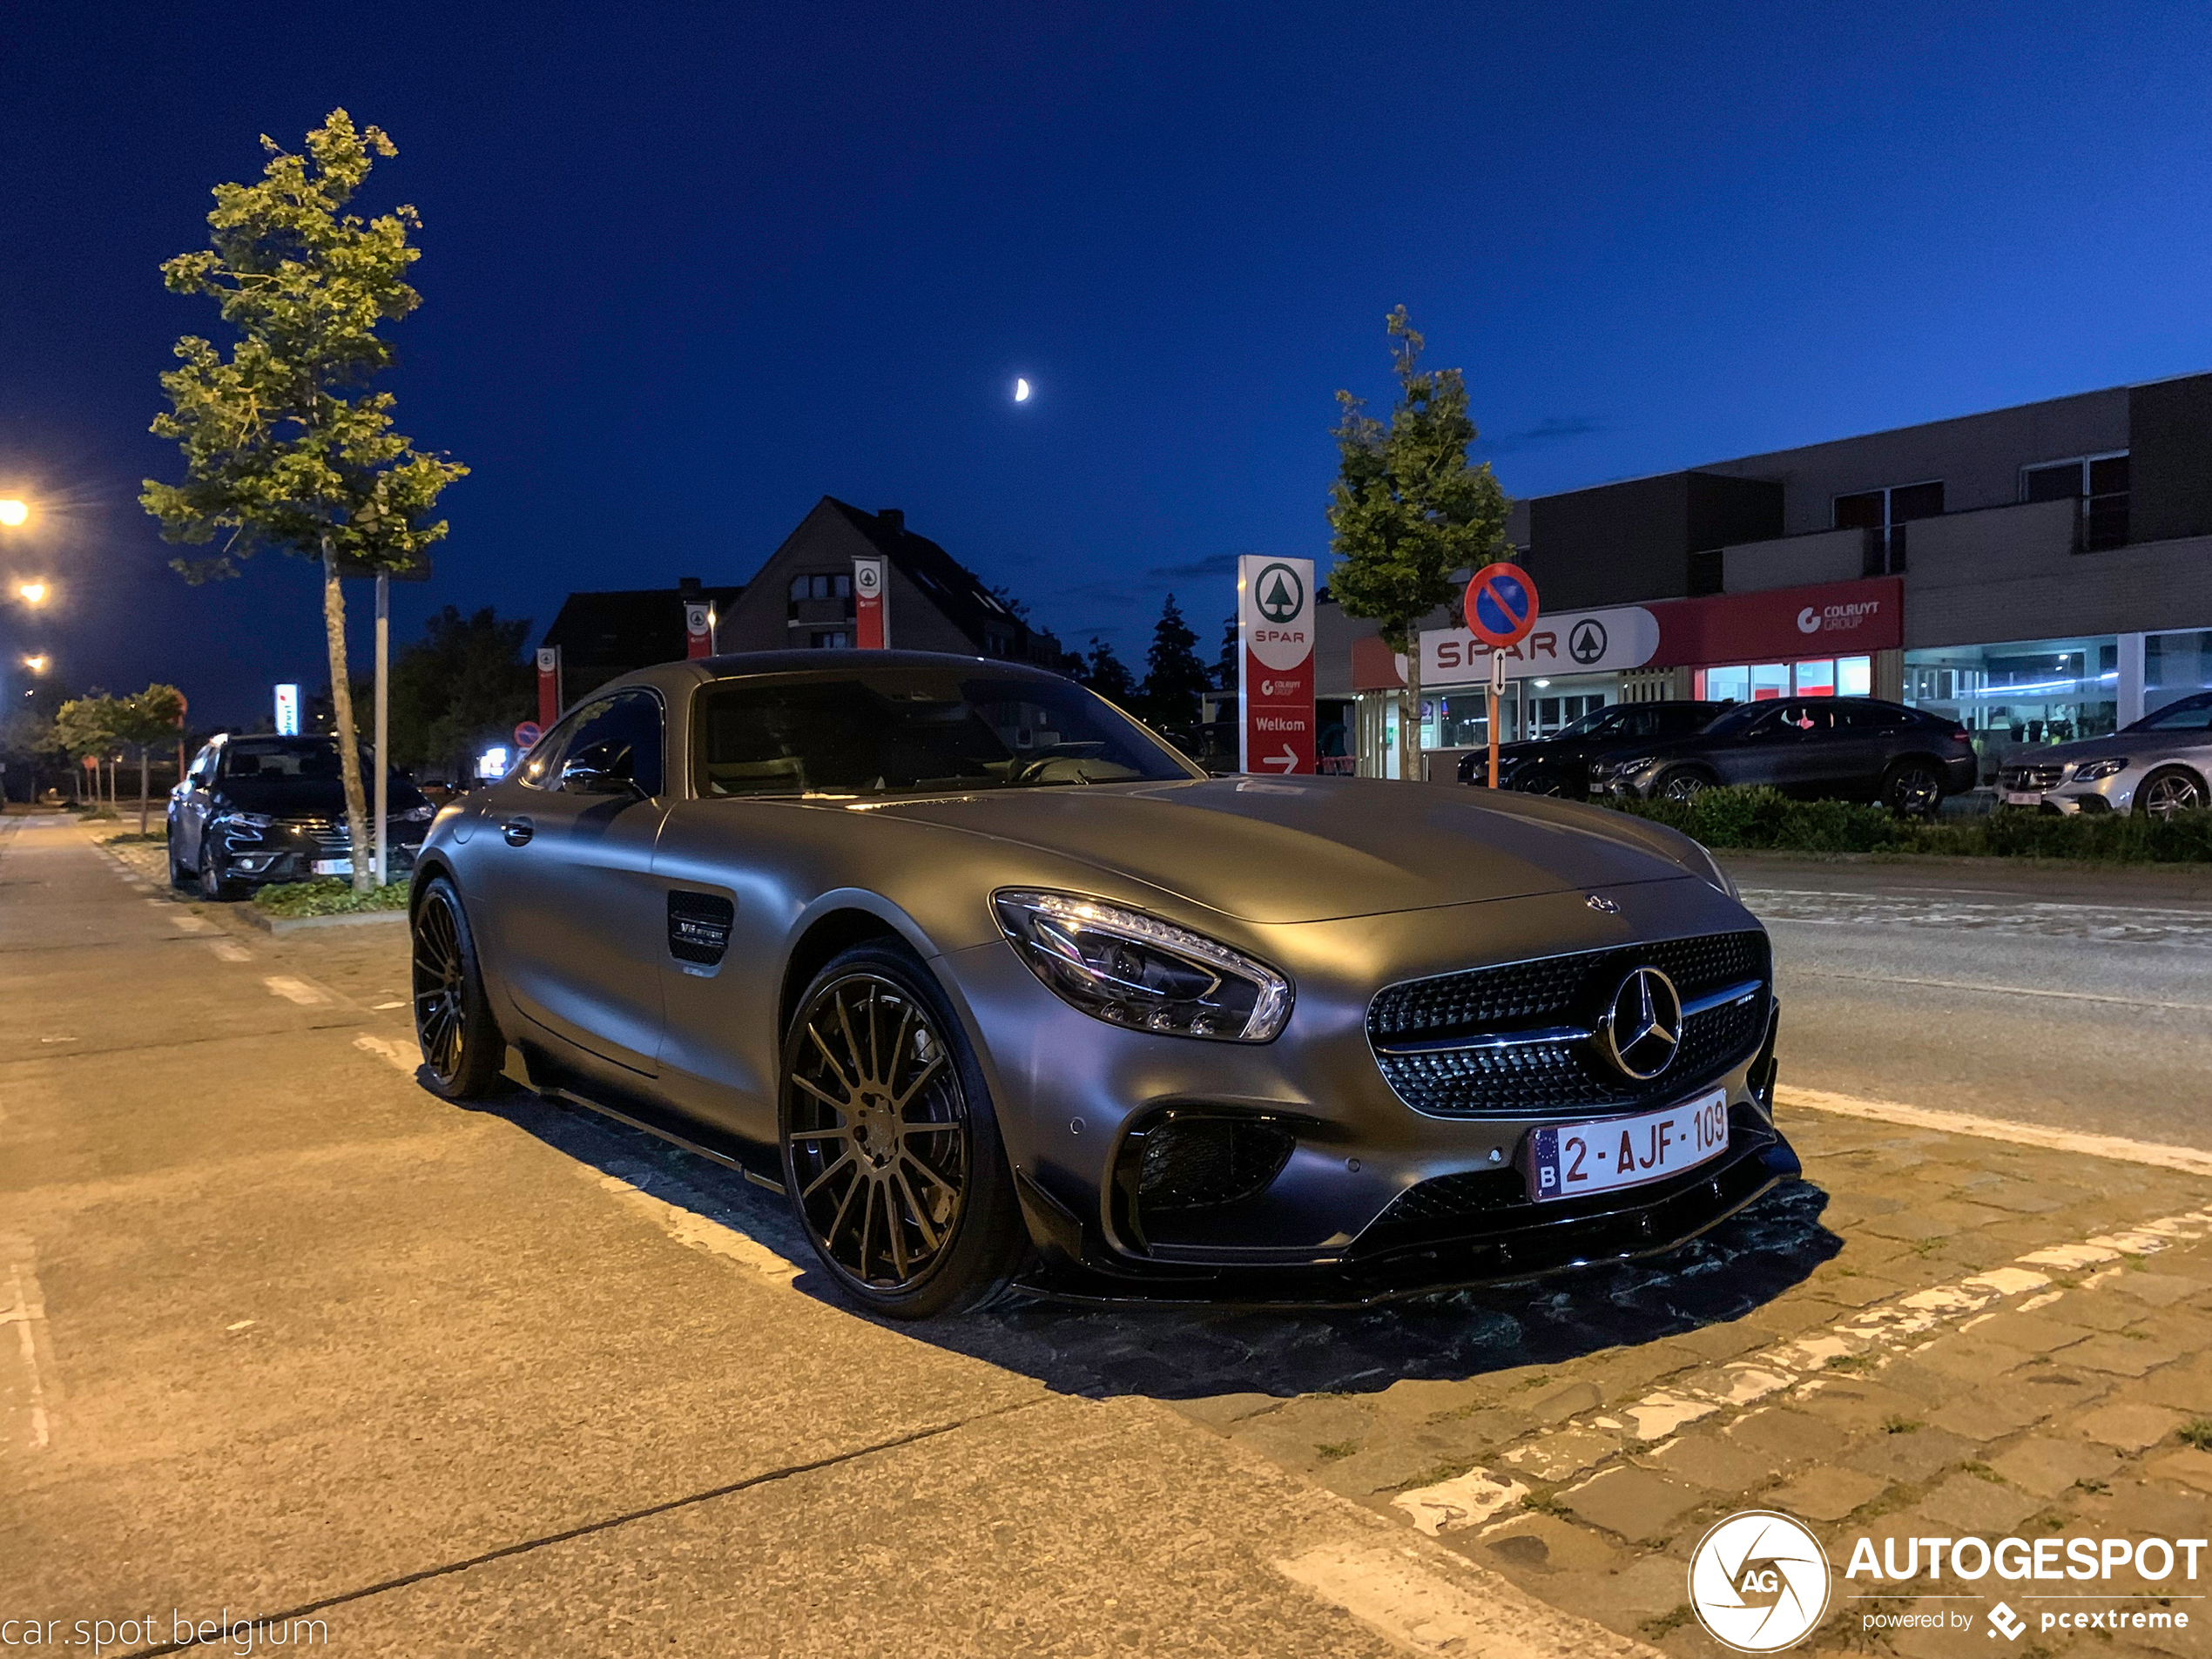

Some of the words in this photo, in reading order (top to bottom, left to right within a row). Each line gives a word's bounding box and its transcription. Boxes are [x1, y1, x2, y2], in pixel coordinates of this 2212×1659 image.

[1824, 601, 1879, 617] COLRUYT
[1824, 616, 1863, 631] GROUP
[1255, 630, 1305, 644] SPAR
[1256, 717, 1305, 732] Welkom
[1540, 1166, 1556, 1188] B
